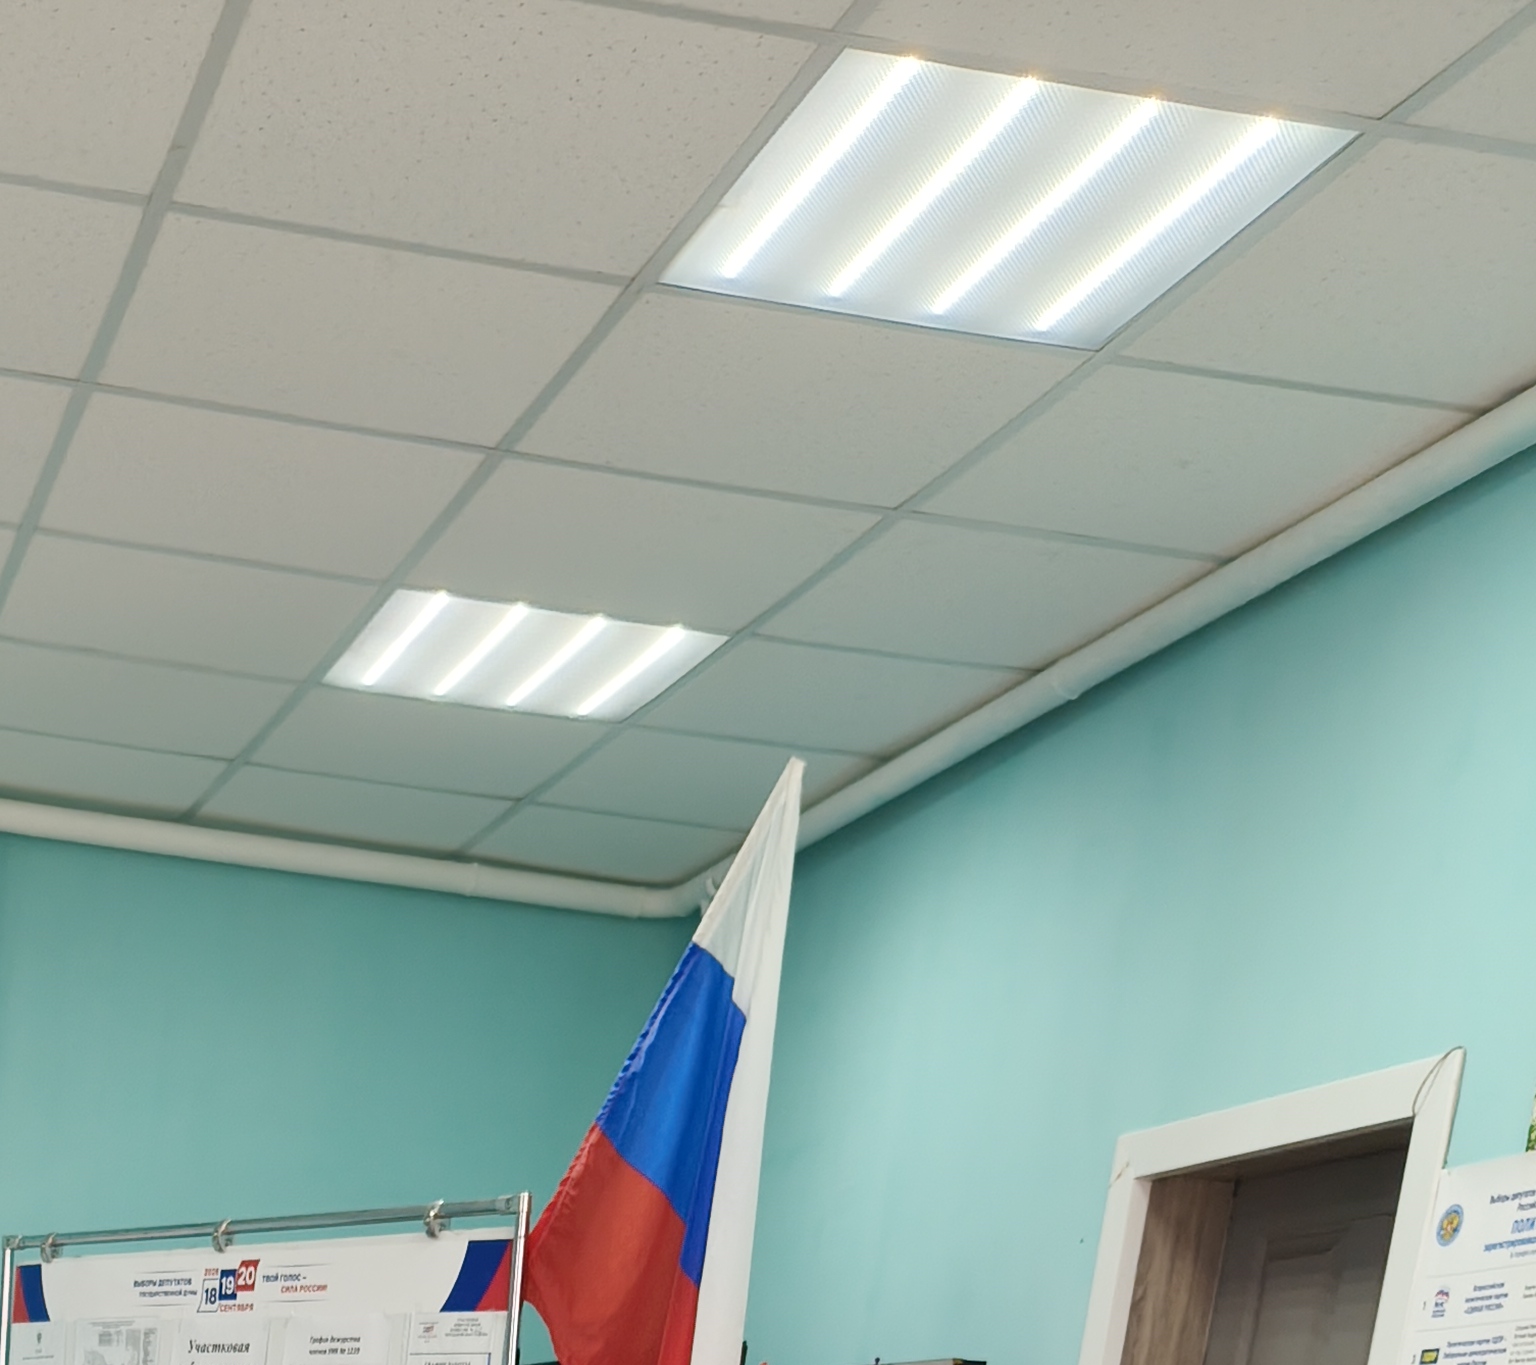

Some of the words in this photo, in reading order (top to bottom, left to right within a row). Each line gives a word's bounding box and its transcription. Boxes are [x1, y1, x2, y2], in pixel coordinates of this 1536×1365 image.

[237, 1266, 255, 1286] 20
[221, 1276, 234, 1295] 19
[205, 1287, 217, 1305] 18
[188, 1339, 250, 1354] Участковая
